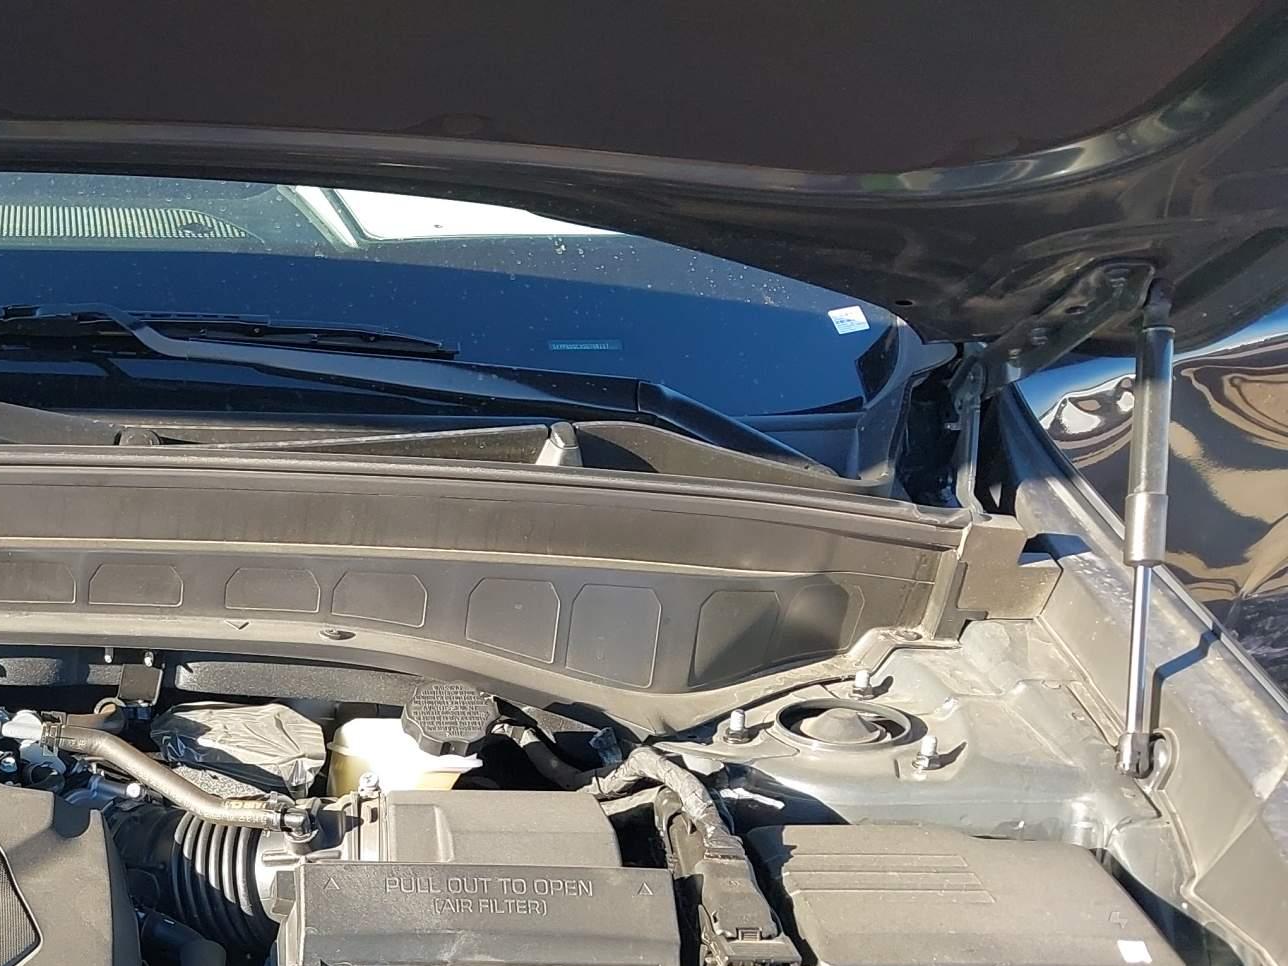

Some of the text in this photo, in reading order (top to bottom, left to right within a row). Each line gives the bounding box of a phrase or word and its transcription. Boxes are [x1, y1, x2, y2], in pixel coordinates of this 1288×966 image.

[385, 877, 593, 897] PULL OUT TO OPEN
[433, 897, 548, 917] (AIR FILTER)
